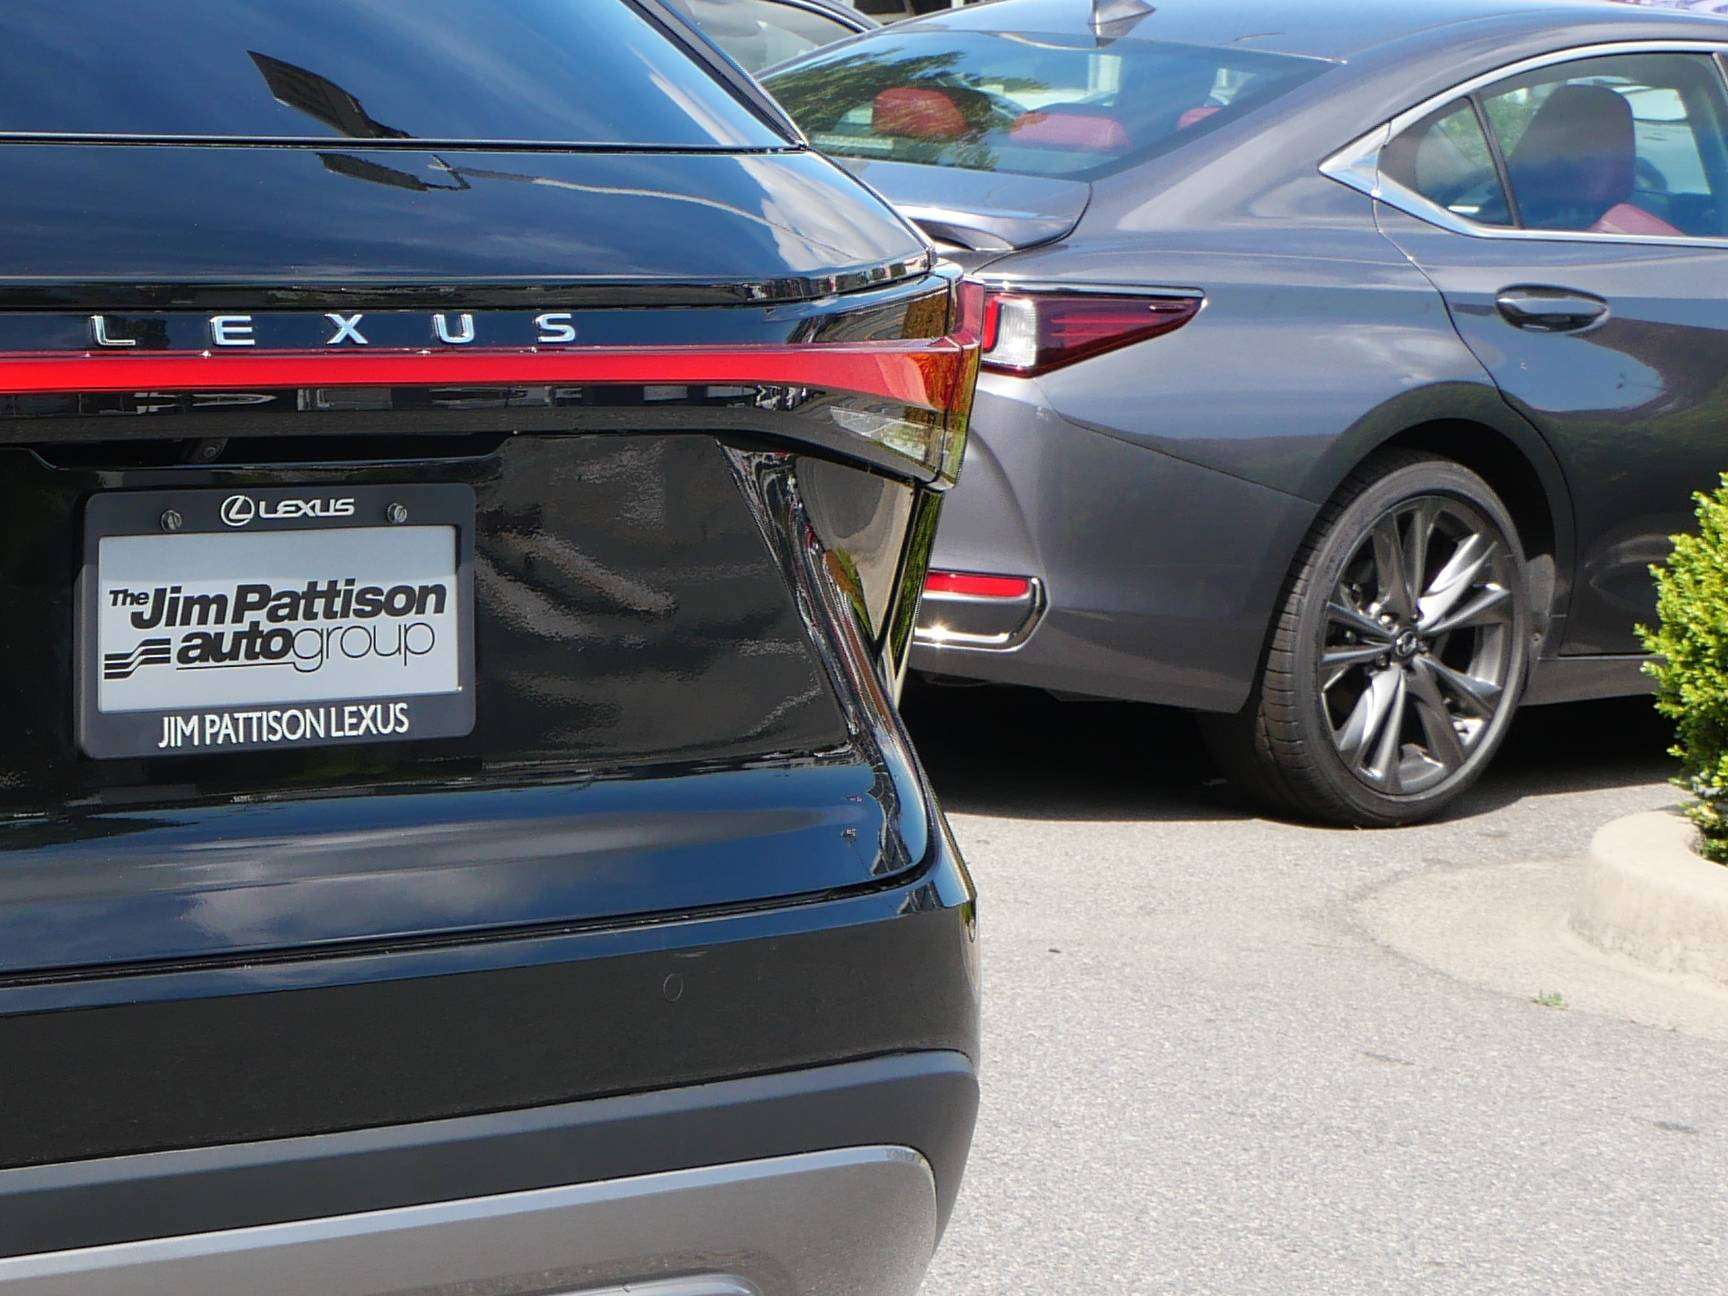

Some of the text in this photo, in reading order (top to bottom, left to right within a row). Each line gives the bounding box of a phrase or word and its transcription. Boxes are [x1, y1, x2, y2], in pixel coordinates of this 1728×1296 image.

[88, 312, 578, 347] LEXUS
[258, 497, 355, 519] LEXUS
[108, 589, 149, 607] The
[158, 703, 410, 749] JIM PATTISON LEXUS
